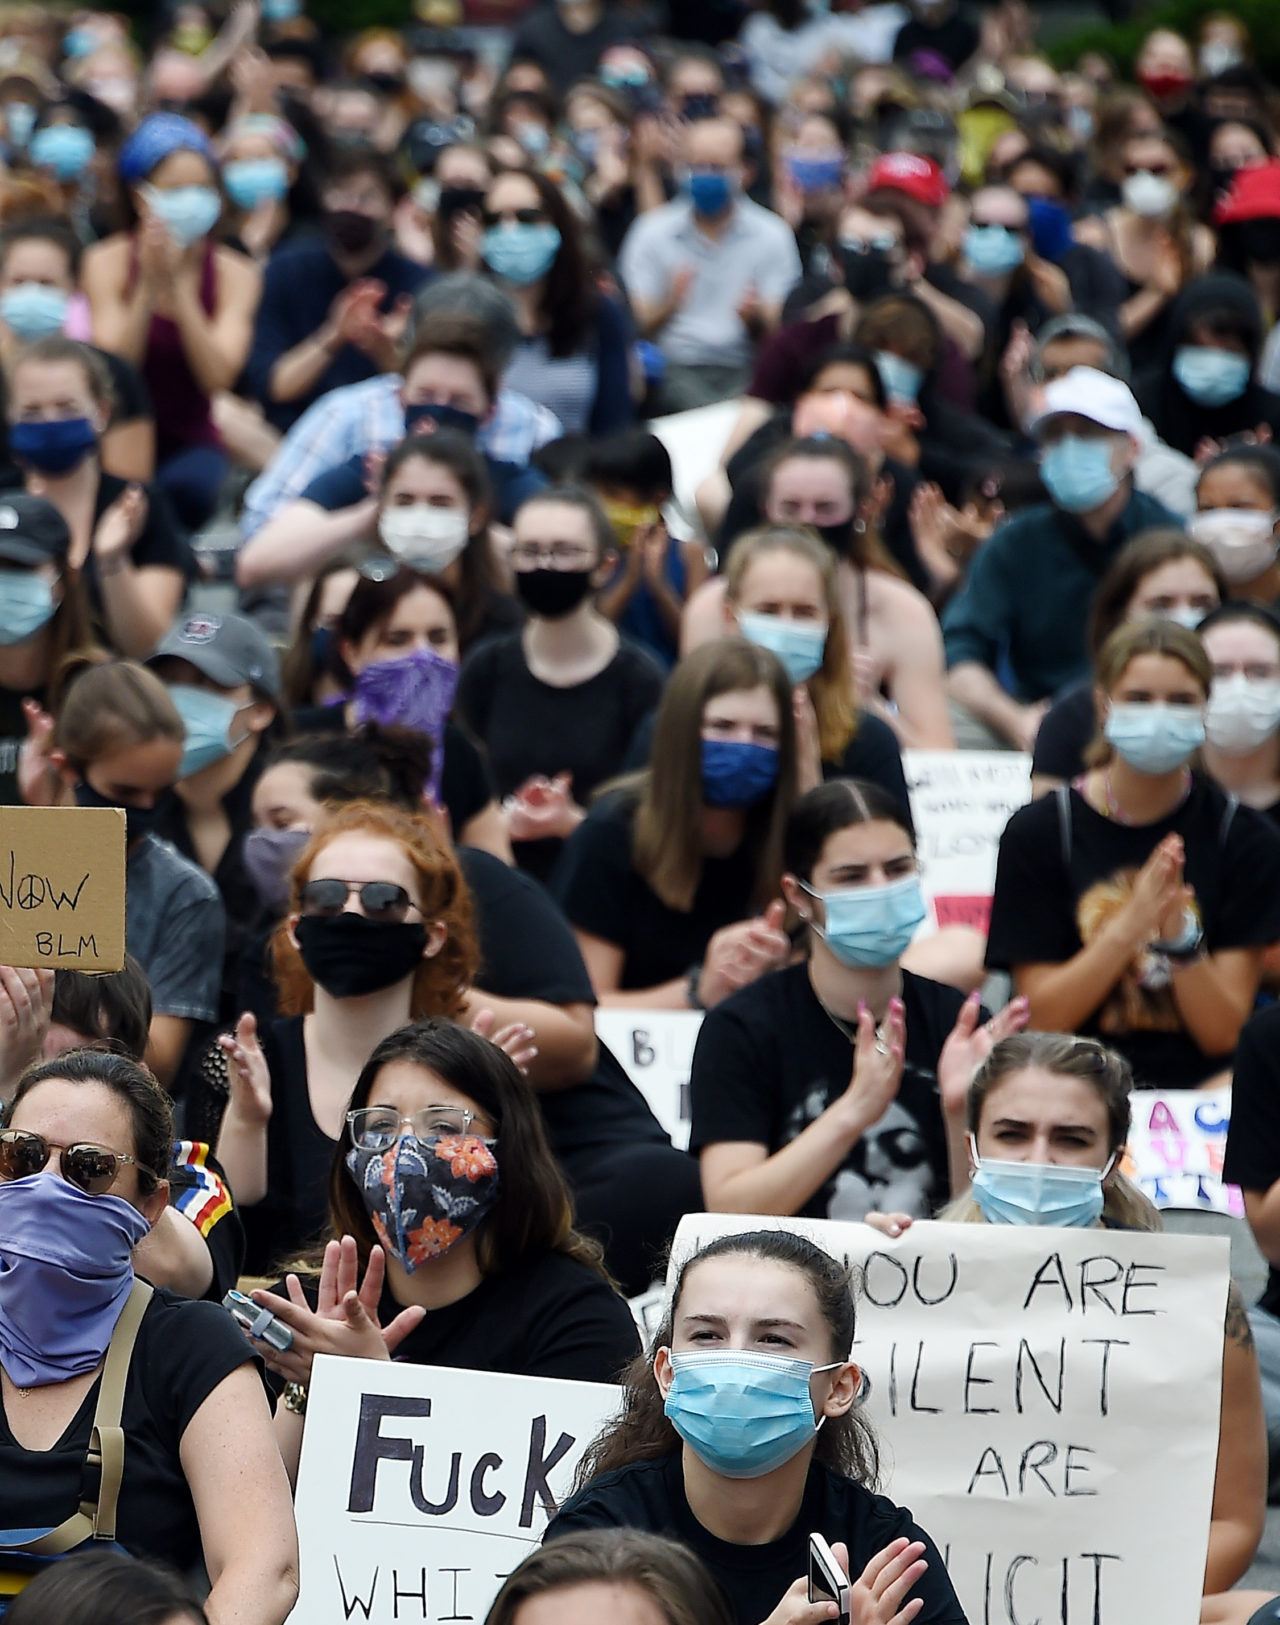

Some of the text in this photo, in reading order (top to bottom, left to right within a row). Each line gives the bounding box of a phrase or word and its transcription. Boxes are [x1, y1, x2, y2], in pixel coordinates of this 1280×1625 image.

[35, 931, 100, 958] BLM
[843, 1250, 1168, 1316] OU ARE
[967, 1440, 1099, 1498] ARE
[333, 1554, 510, 1621] WHI
[942, 1543, 1124, 1625] ICIT
